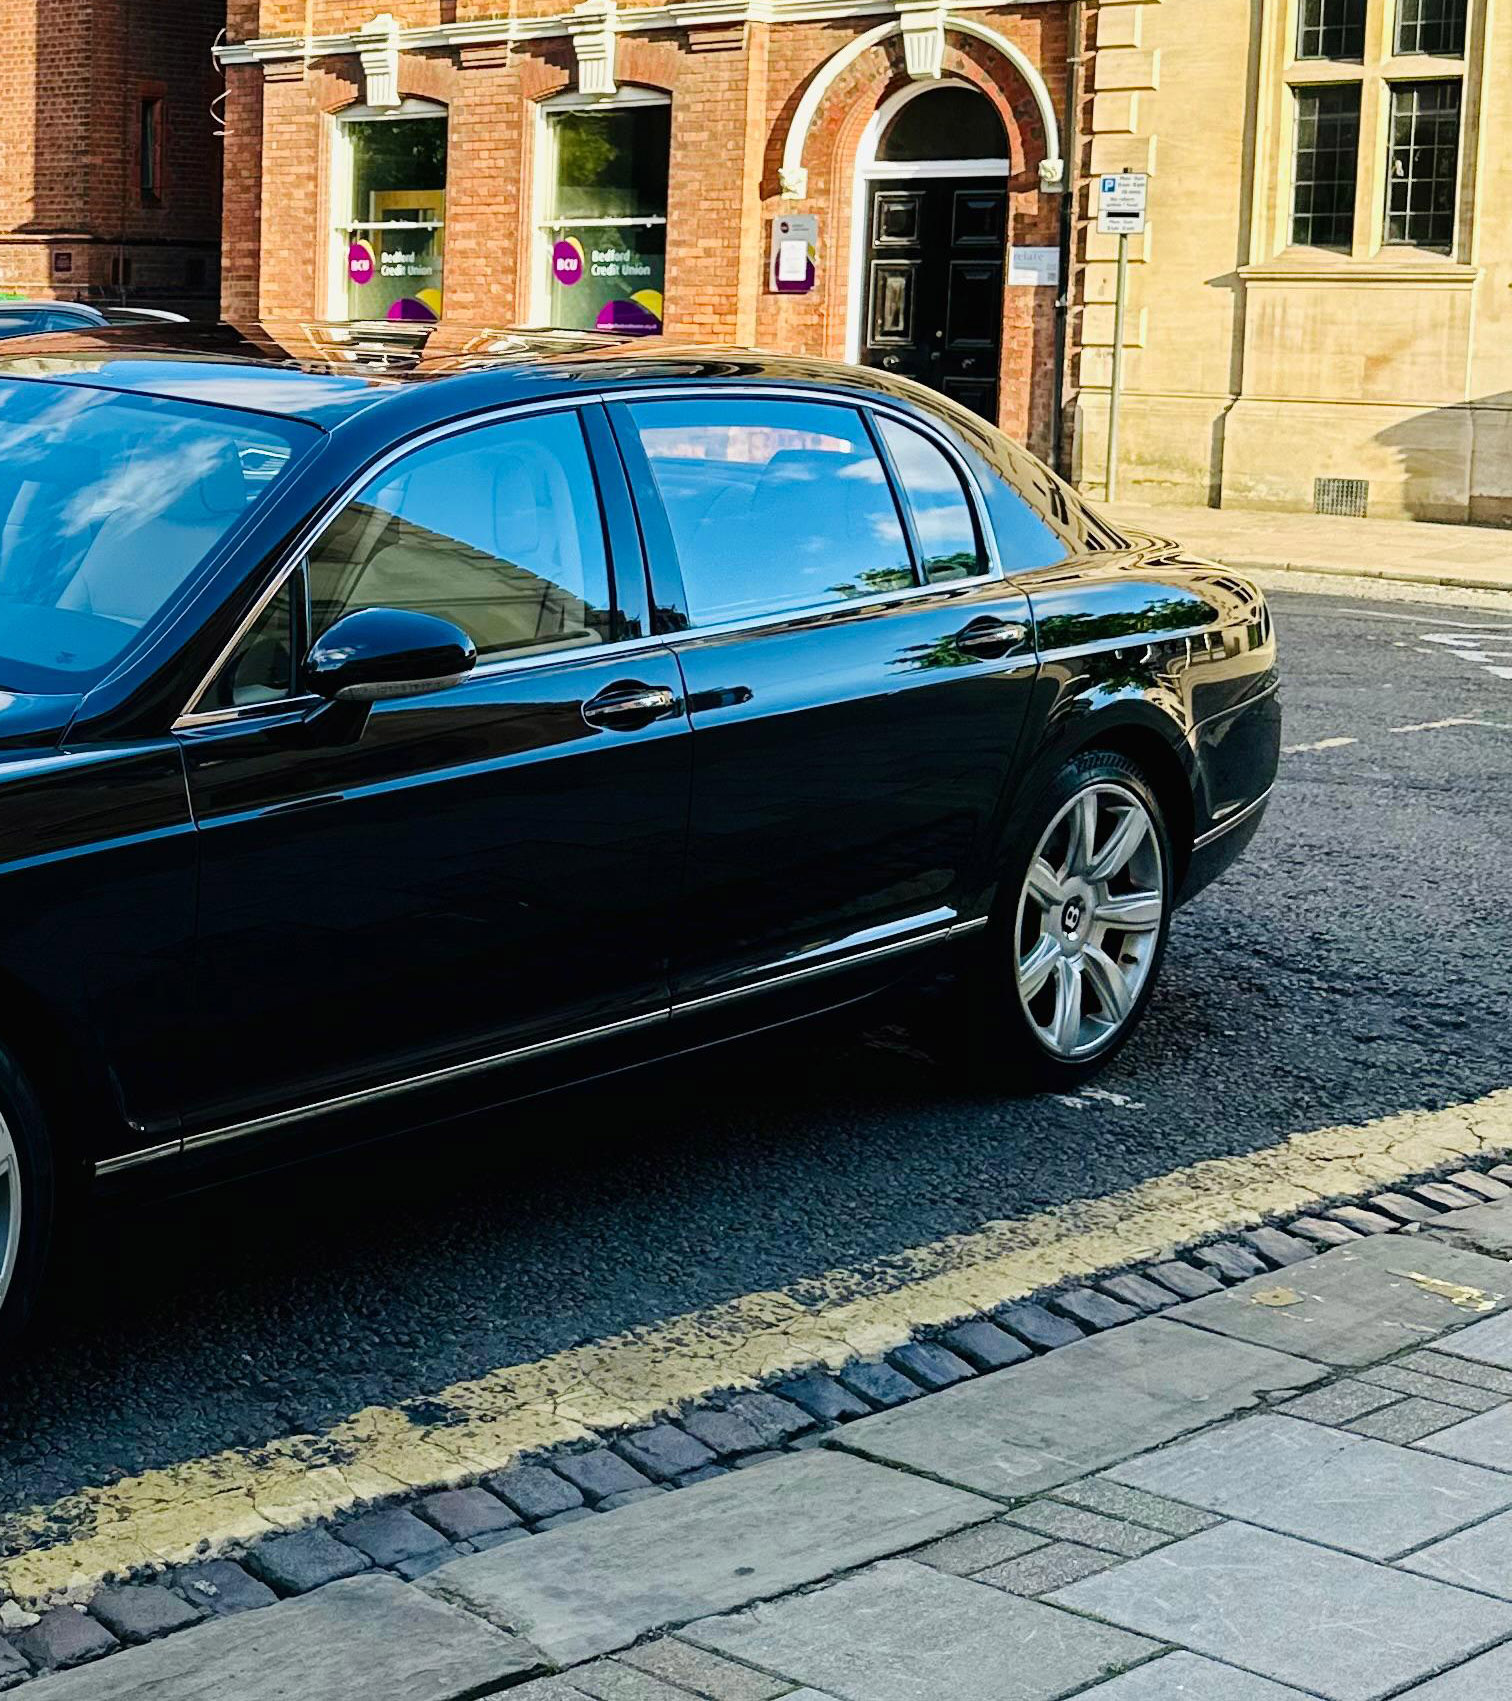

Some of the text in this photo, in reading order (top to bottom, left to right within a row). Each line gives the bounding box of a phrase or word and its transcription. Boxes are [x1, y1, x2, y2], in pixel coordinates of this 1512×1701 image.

[381, 251, 415, 263] Bedford
[592, 249, 631, 262] Bedford
[381, 264, 433, 276] Credit Union
[556, 258, 578, 271] BCU
[591, 263, 651, 276] Credit Union
